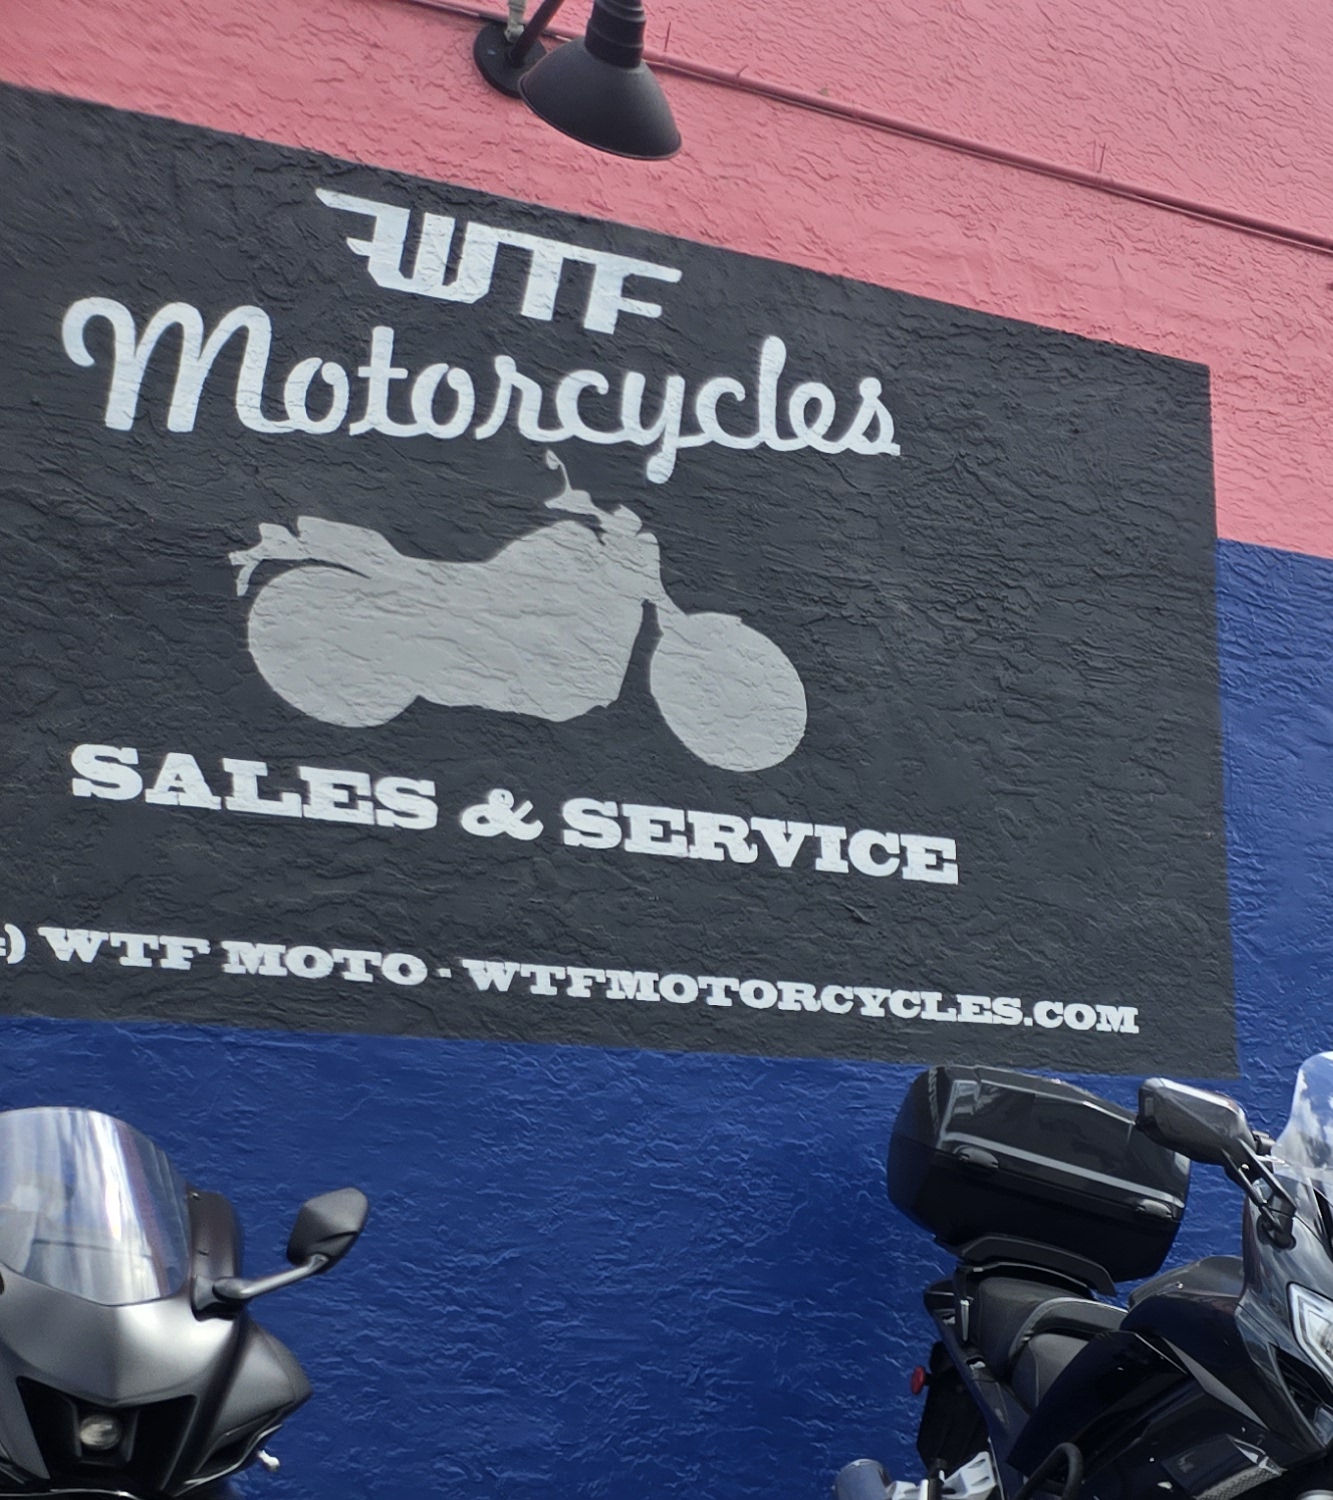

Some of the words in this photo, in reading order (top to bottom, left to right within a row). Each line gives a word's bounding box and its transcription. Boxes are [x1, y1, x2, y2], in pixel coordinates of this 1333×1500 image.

[315, 187, 683, 334] WTF
[61, 295, 901, 484] Motorcycles
[68, 743, 437, 833] SALES
[459, 788, 544, 842] &
[562, 797, 960, 886] SERVICE
[37, 926, 210, 971] WTF
[222, 941, 429, 986] MOTO
[465, 957, 1141, 1034] WTFMOTORCYCLES.COM
